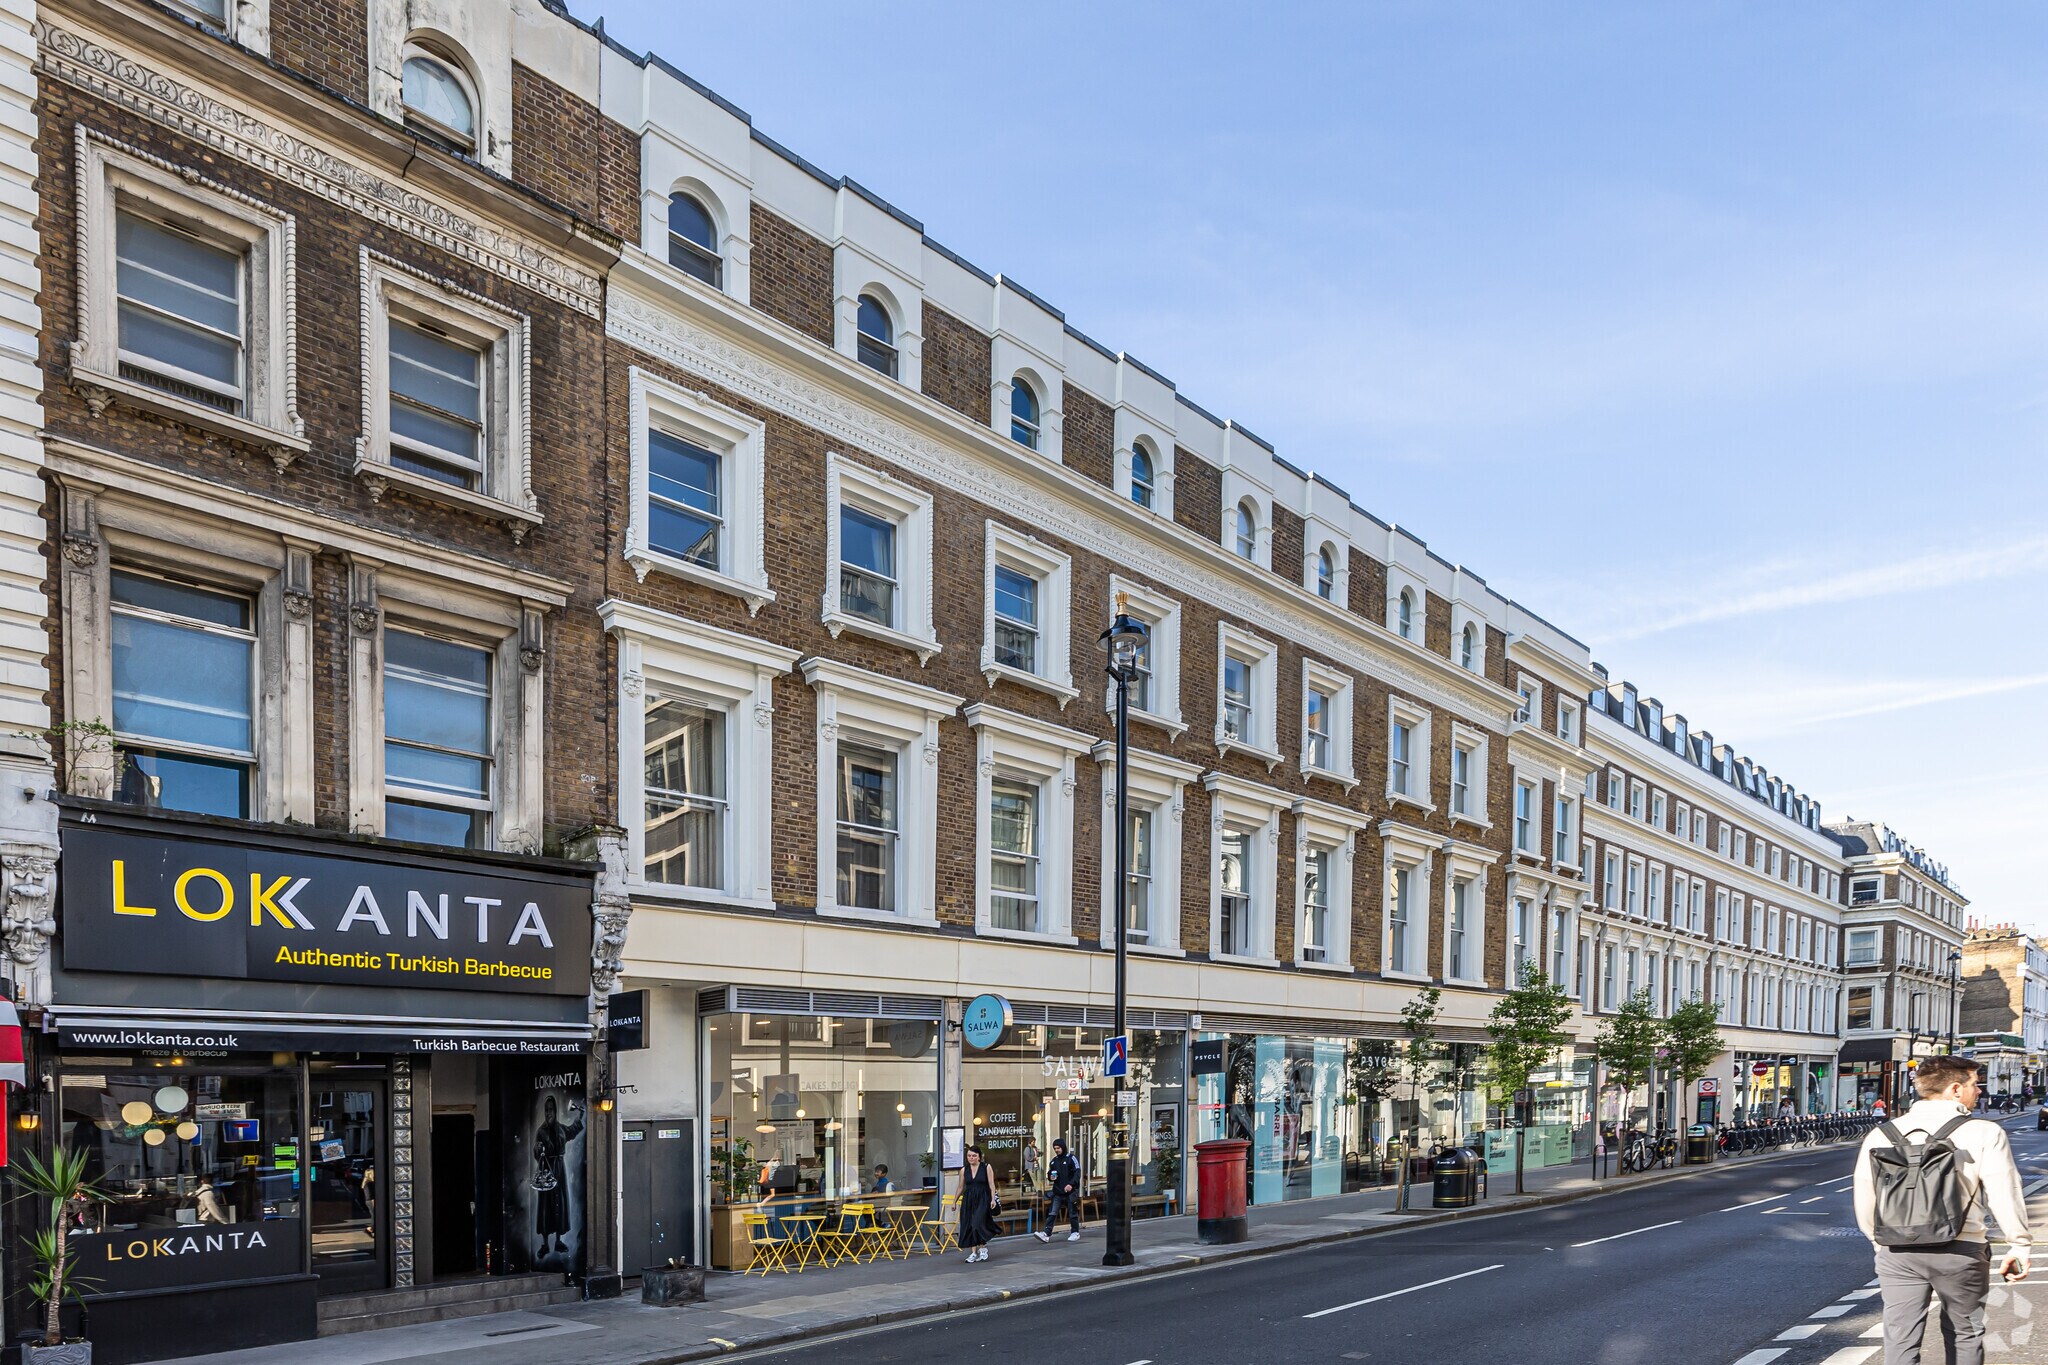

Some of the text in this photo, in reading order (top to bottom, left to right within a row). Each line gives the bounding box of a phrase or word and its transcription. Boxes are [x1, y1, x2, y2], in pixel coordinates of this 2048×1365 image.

[112, 859, 554, 949] LOKKANTA
[275, 945, 553, 980] Authentic Turkish Barbecue
[609, 1015, 642, 1028] LOKKANTA
[967, 1020, 999, 1033] SALWA
[72, 1030, 239, 1048] www.lokkanta.co.uk
[412, 1038, 580, 1053] Turkish Barbecue Restaurant
[141, 1049, 170, 1057] meze
[182, 1048, 228, 1058] barbecue
[1194, 1053, 1221, 1061] PSYCLE
[534, 1072, 582, 1090] LOKKANTA
[989, 1112, 1017, 1123] COFFEE
[1273, 1097, 1281, 1138] BARRE
[978, 1125, 1027, 1137] SANDWICHES
[987, 1139, 1019, 1150] BRUNCH
[107, 1230, 267, 1261] LOKKANTA
